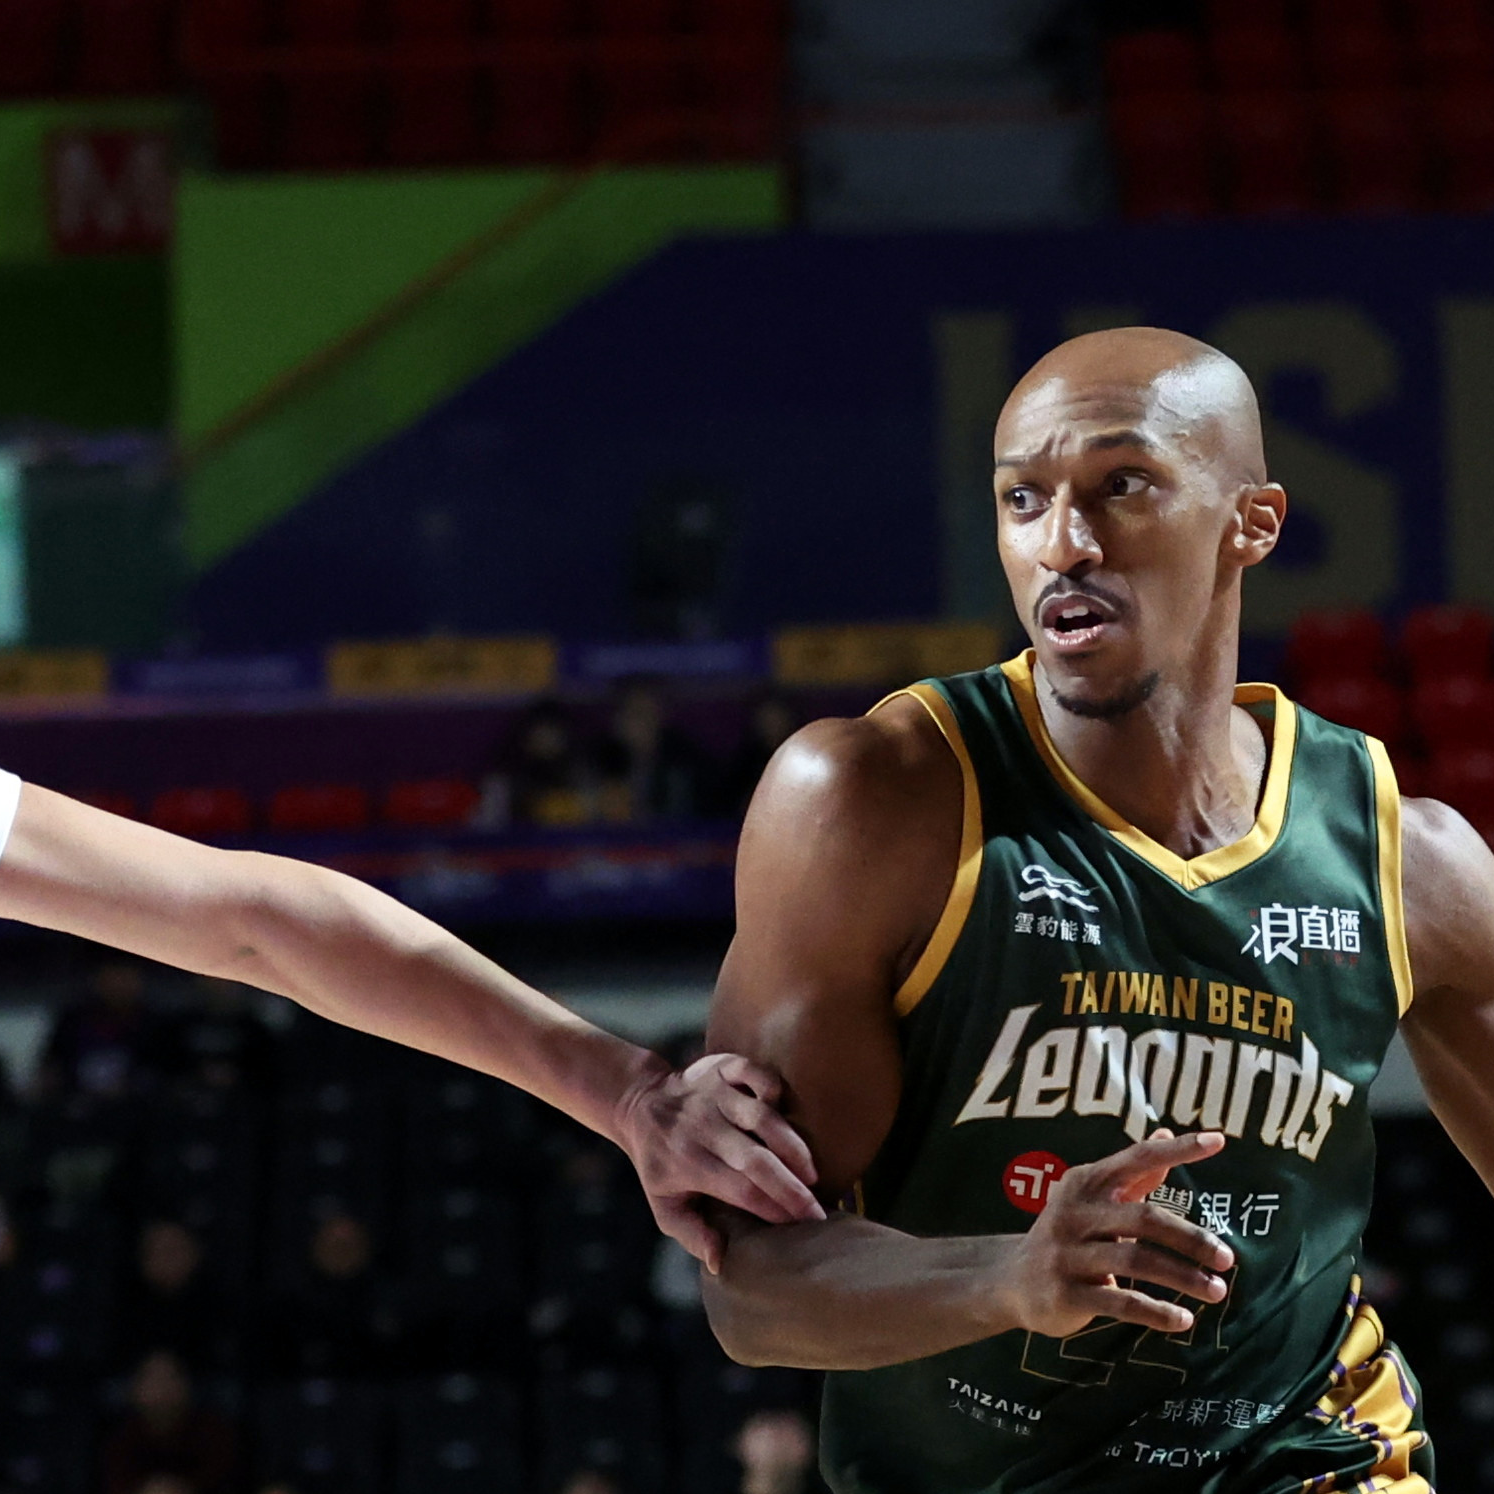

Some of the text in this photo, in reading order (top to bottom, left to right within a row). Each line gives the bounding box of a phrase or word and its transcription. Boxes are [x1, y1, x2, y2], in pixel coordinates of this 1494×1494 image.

[1014, 911, 1102, 946] 雲豹能源
[1241, 903, 1361, 966] 浪直播
[1060, 970, 1295, 1043] TAIWAN BEER
[947, 1377, 1043, 1421] TAIZAKU
